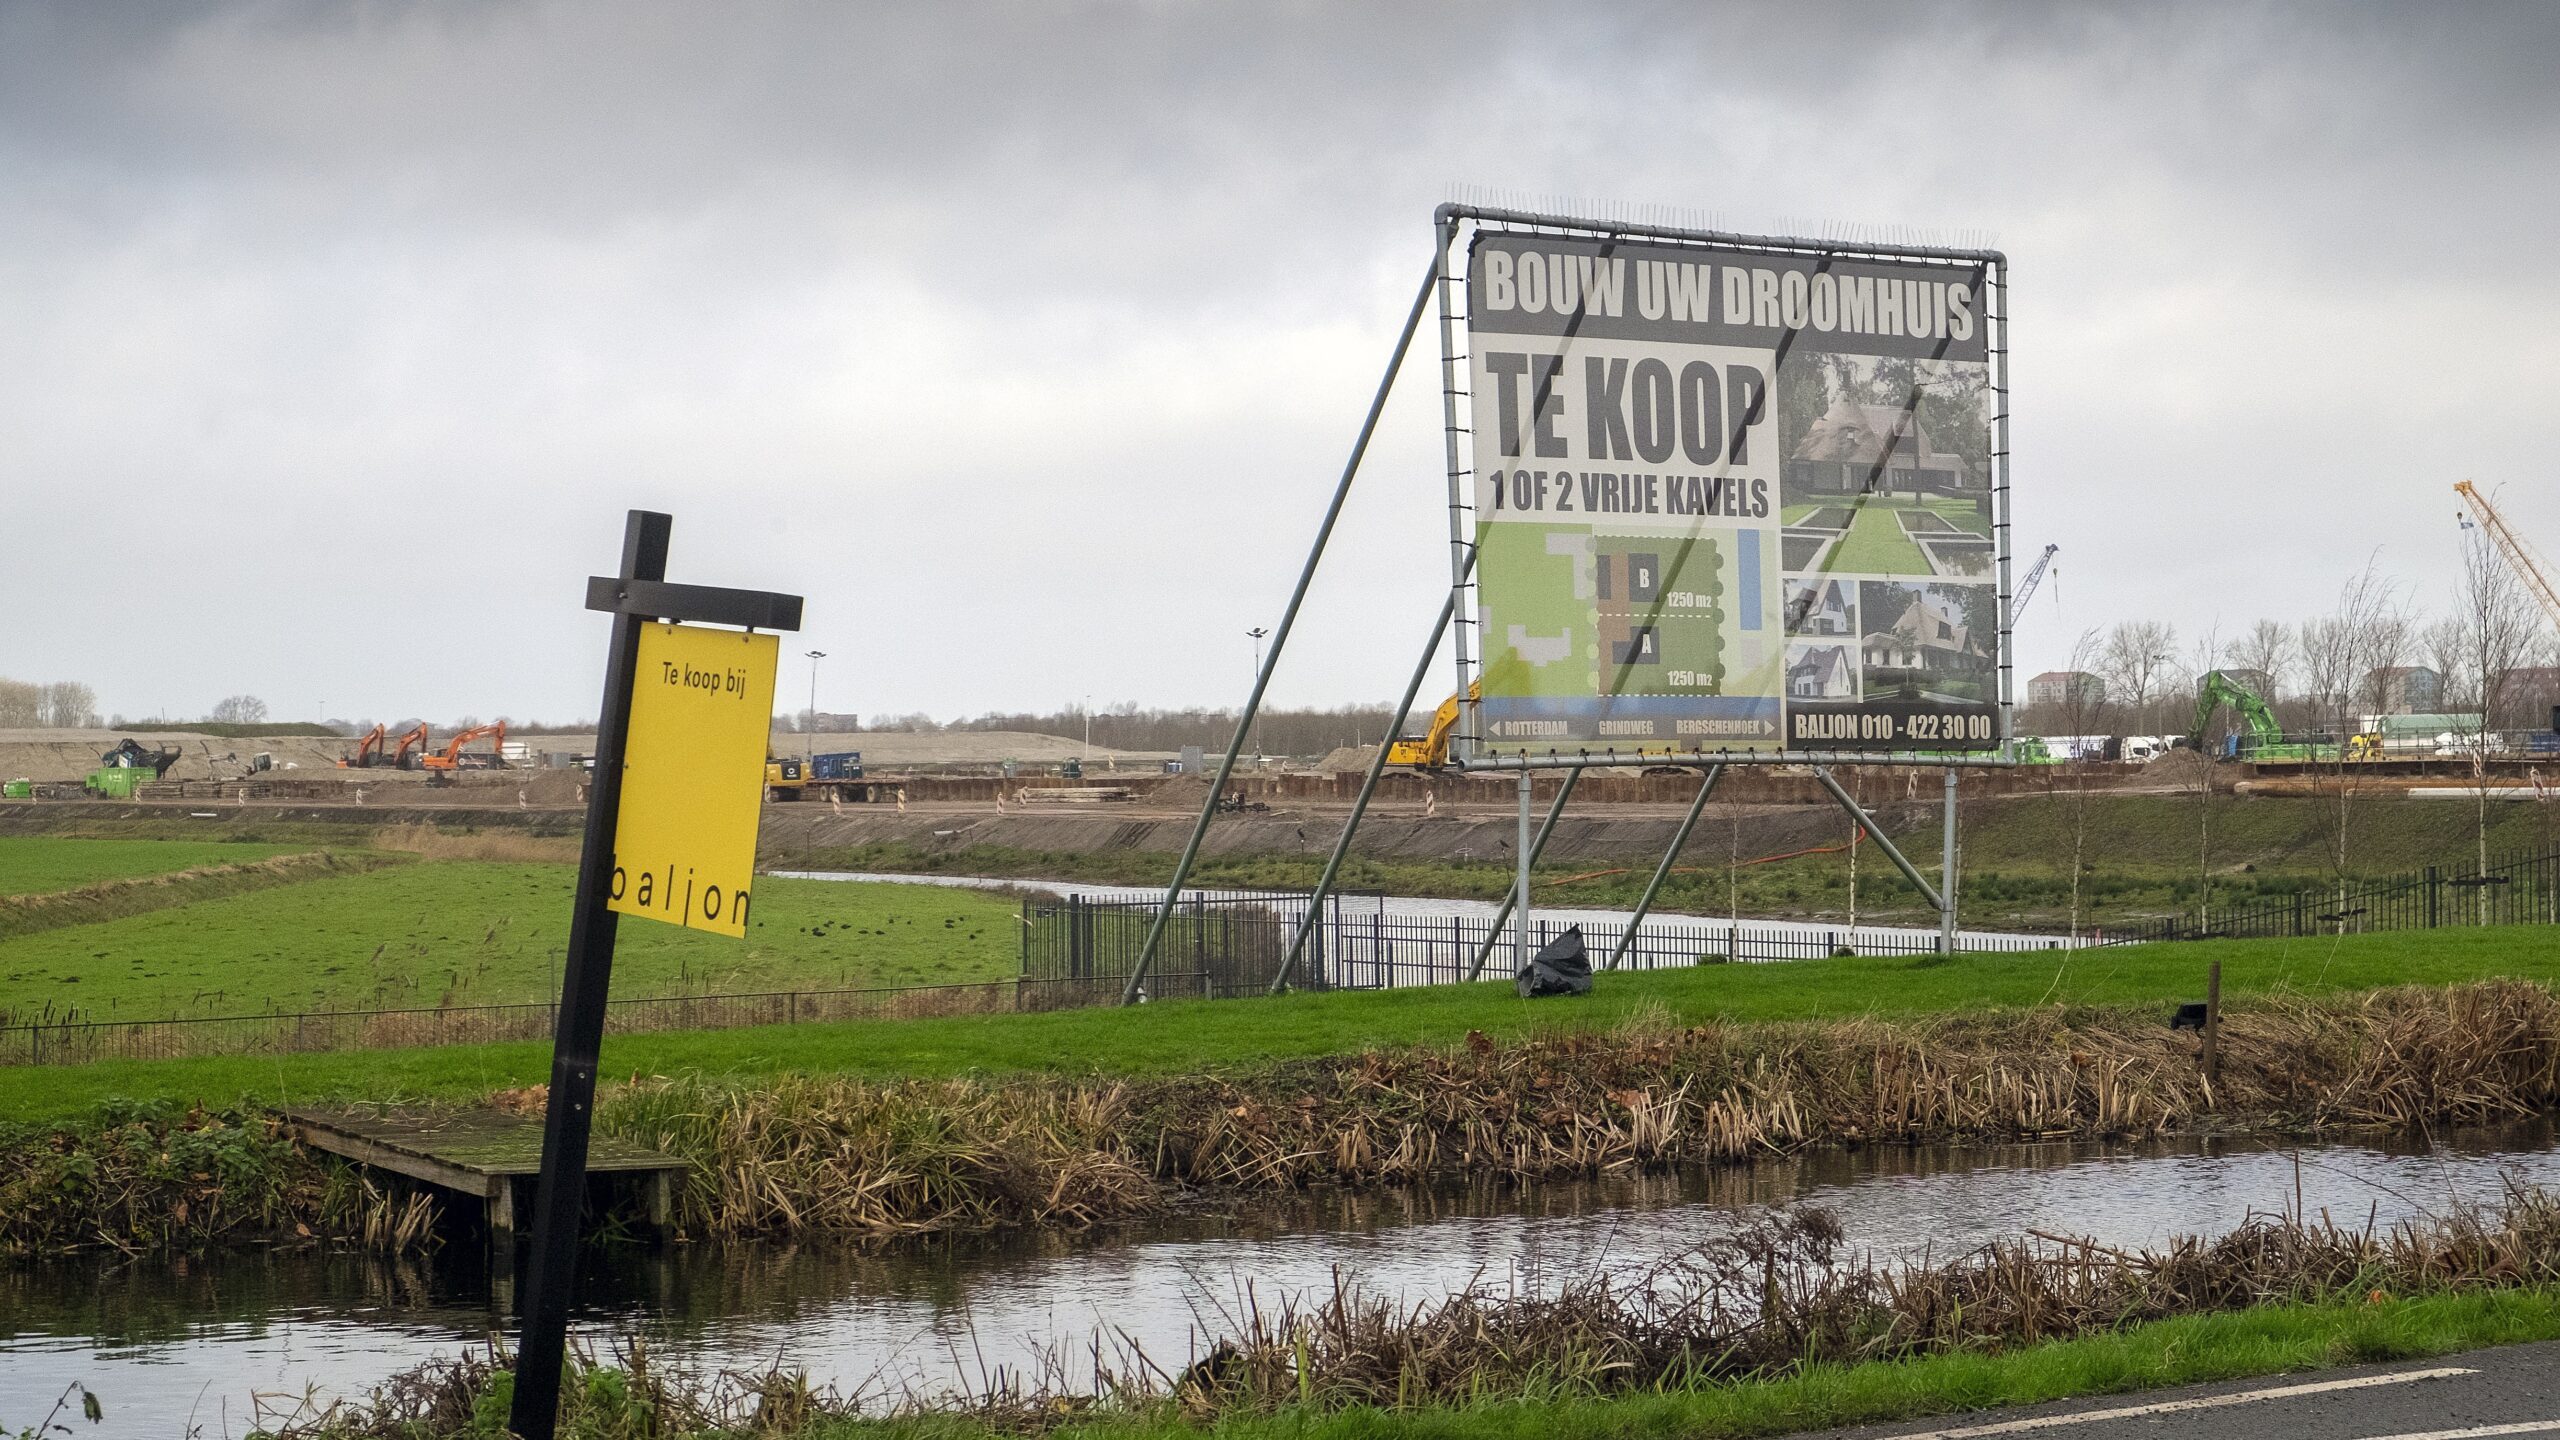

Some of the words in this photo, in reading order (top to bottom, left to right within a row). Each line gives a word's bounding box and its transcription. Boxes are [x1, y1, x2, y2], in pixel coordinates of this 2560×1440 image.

[1485, 250, 1625, 318] BOUW
[1636, 260, 1711, 323] UW
[1722, 266, 1975, 342] DROOMHUIS
[1485, 351, 1568, 459] TE
[1585, 357, 1767, 467] KOOP
[1489, 470, 1505, 510] 1
[1512, 469, 1549, 512] OF
[1555, 471, 1574, 512] 2
[1579, 472, 1660, 515] VRIJE
[1665, 475, 1769, 519] KAVELS
[1638, 568, 1650, 588] B
[1666, 591, 1694, 608] 1250
[1641, 632, 1653, 654] A
[662, 661, 678, 685] Te
[683, 663, 721, 697] koop
[726, 667, 747, 700] bij
[1667, 670, 1695, 687] 1250
[1505, 720, 1568, 736] ROTTERDAM
[1599, 720, 1654, 736] GRINDWEG
[1676, 719, 1760, 735] BERGSCHENHOEK
[1795, 714, 1858, 740] BALJON
[1861, 714, 1893, 740] 010
[1906, 714, 1939, 740] 422
[1942, 714, 1965, 740] 30
[1968, 714, 1991, 740] 00
[609, 853, 750, 928] baljon
